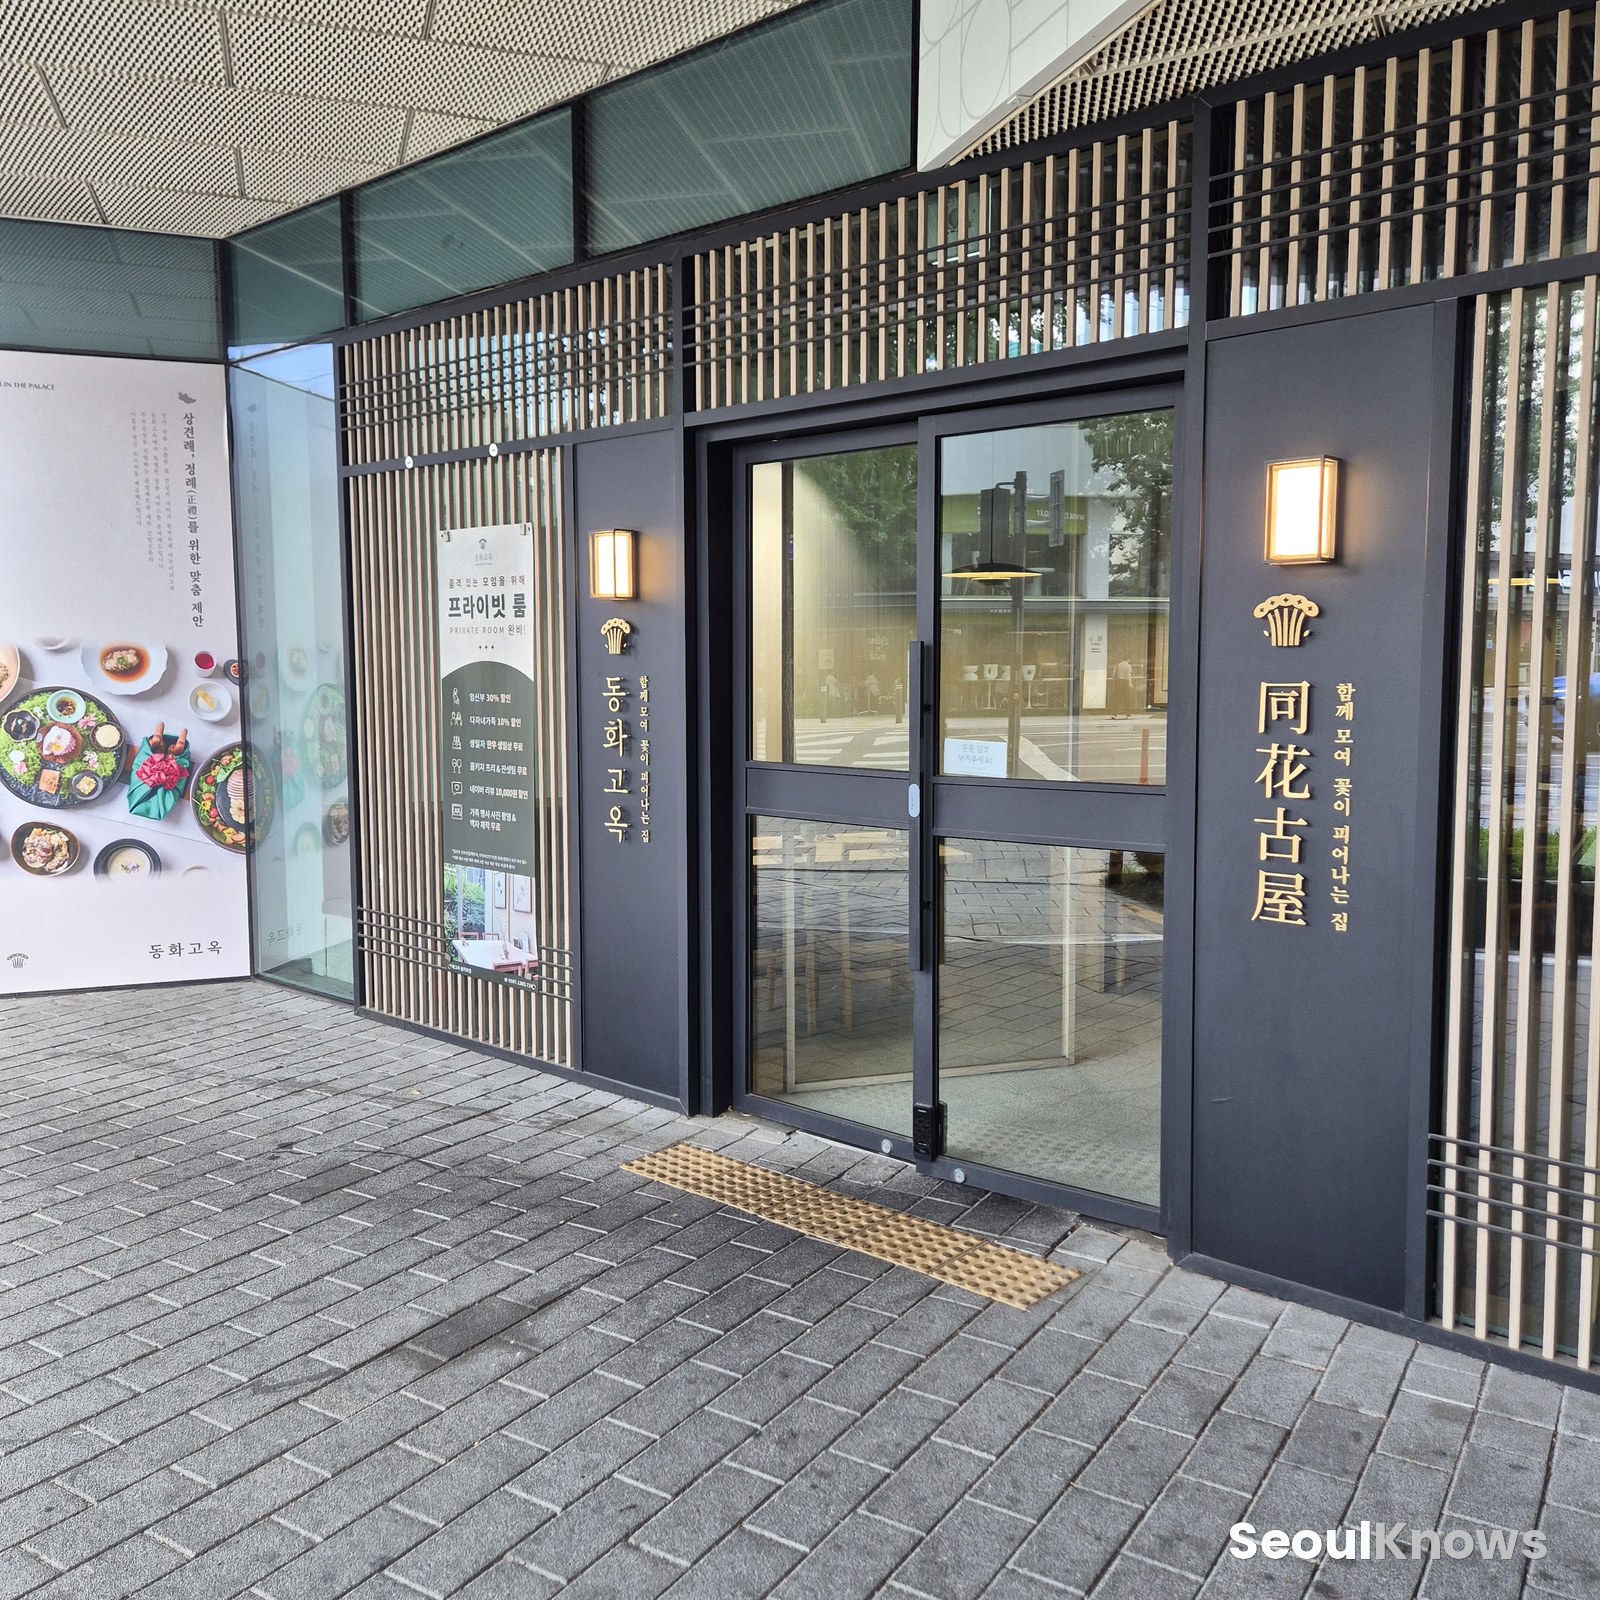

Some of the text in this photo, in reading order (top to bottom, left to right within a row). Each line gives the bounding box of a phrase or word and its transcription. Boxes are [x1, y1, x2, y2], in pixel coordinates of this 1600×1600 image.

[13, 381, 26, 389] THE
[28, 382, 55, 391] PALACE
[189, 539, 201, 565] 위한
[190, 570, 202, 597] 맞춤
[465, 577, 478, 588] 있는
[482, 575, 505, 587] 모임을
[510, 574, 525, 586] 위해
[192, 601, 204, 628] 제안
[448, 593, 527, 620] 프라이빗 룸
[450, 624, 526, 636] PRIVATE ROOM 완비!
[485, 693, 499, 702] 30%
[497, 717, 510, 727] 10%
[513, 742, 523, 751] 무료
[602, 677, 630, 843] 동화고옥
[639, 675, 650, 843] 함께 모여 꽃이 피어나는 집
[517, 766, 527, 776] 무료
[1251, 680, 1312, 926] 同花古屋
[1330, 683, 1356, 932] 함께 모여 꽃이 피어나는 집
[490, 822, 501, 832] 무료
[149, 940, 222, 960] 동화고옥
